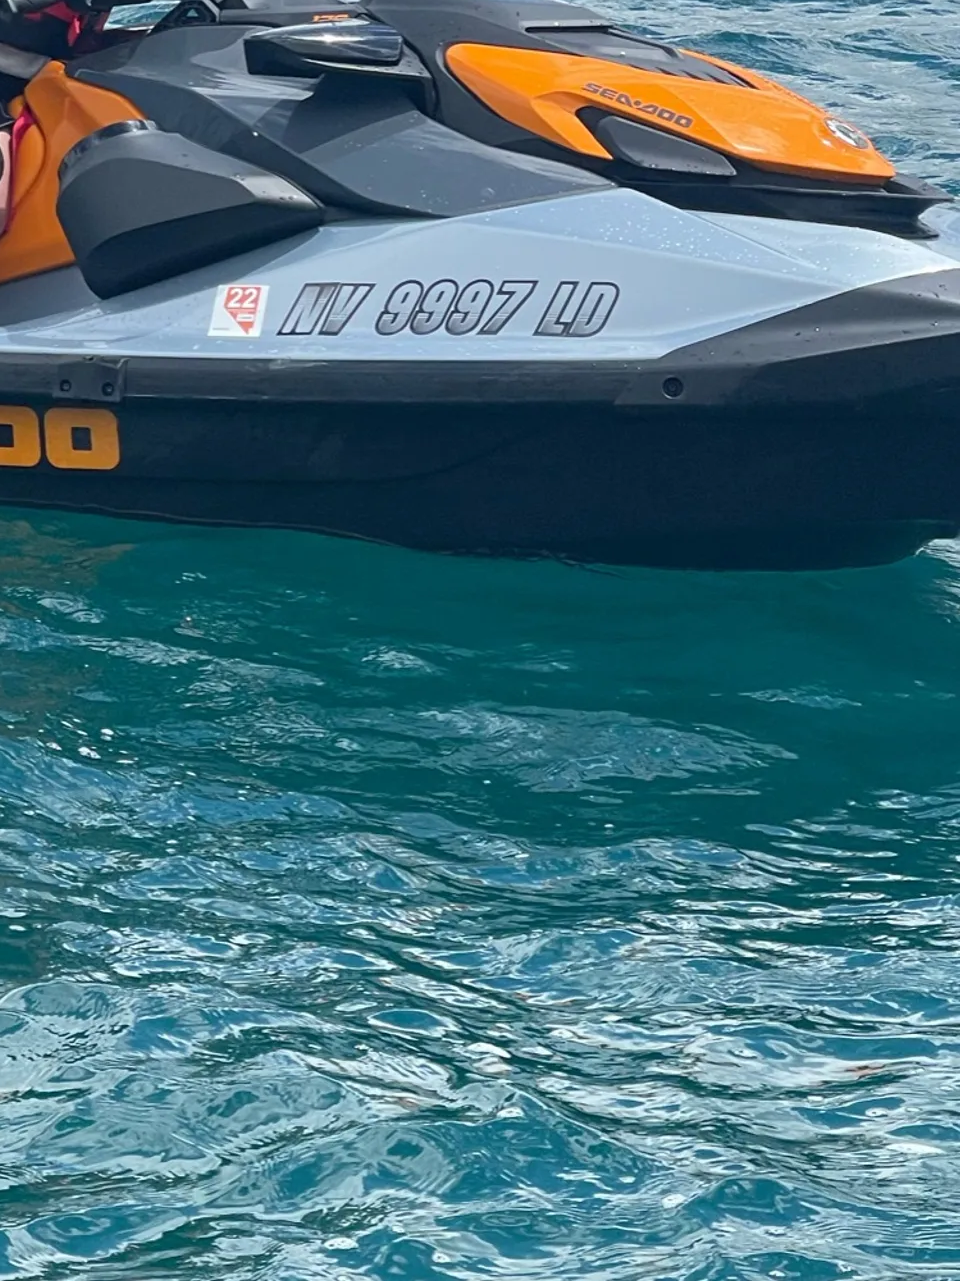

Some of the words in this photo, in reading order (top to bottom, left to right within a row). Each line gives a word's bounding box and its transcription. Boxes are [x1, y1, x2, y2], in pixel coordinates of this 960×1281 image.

[227, 288, 258, 308] 22
[276, 281, 377, 336] NV
[374, 279, 539, 336] 9997
[532, 281, 621, 337] LD
